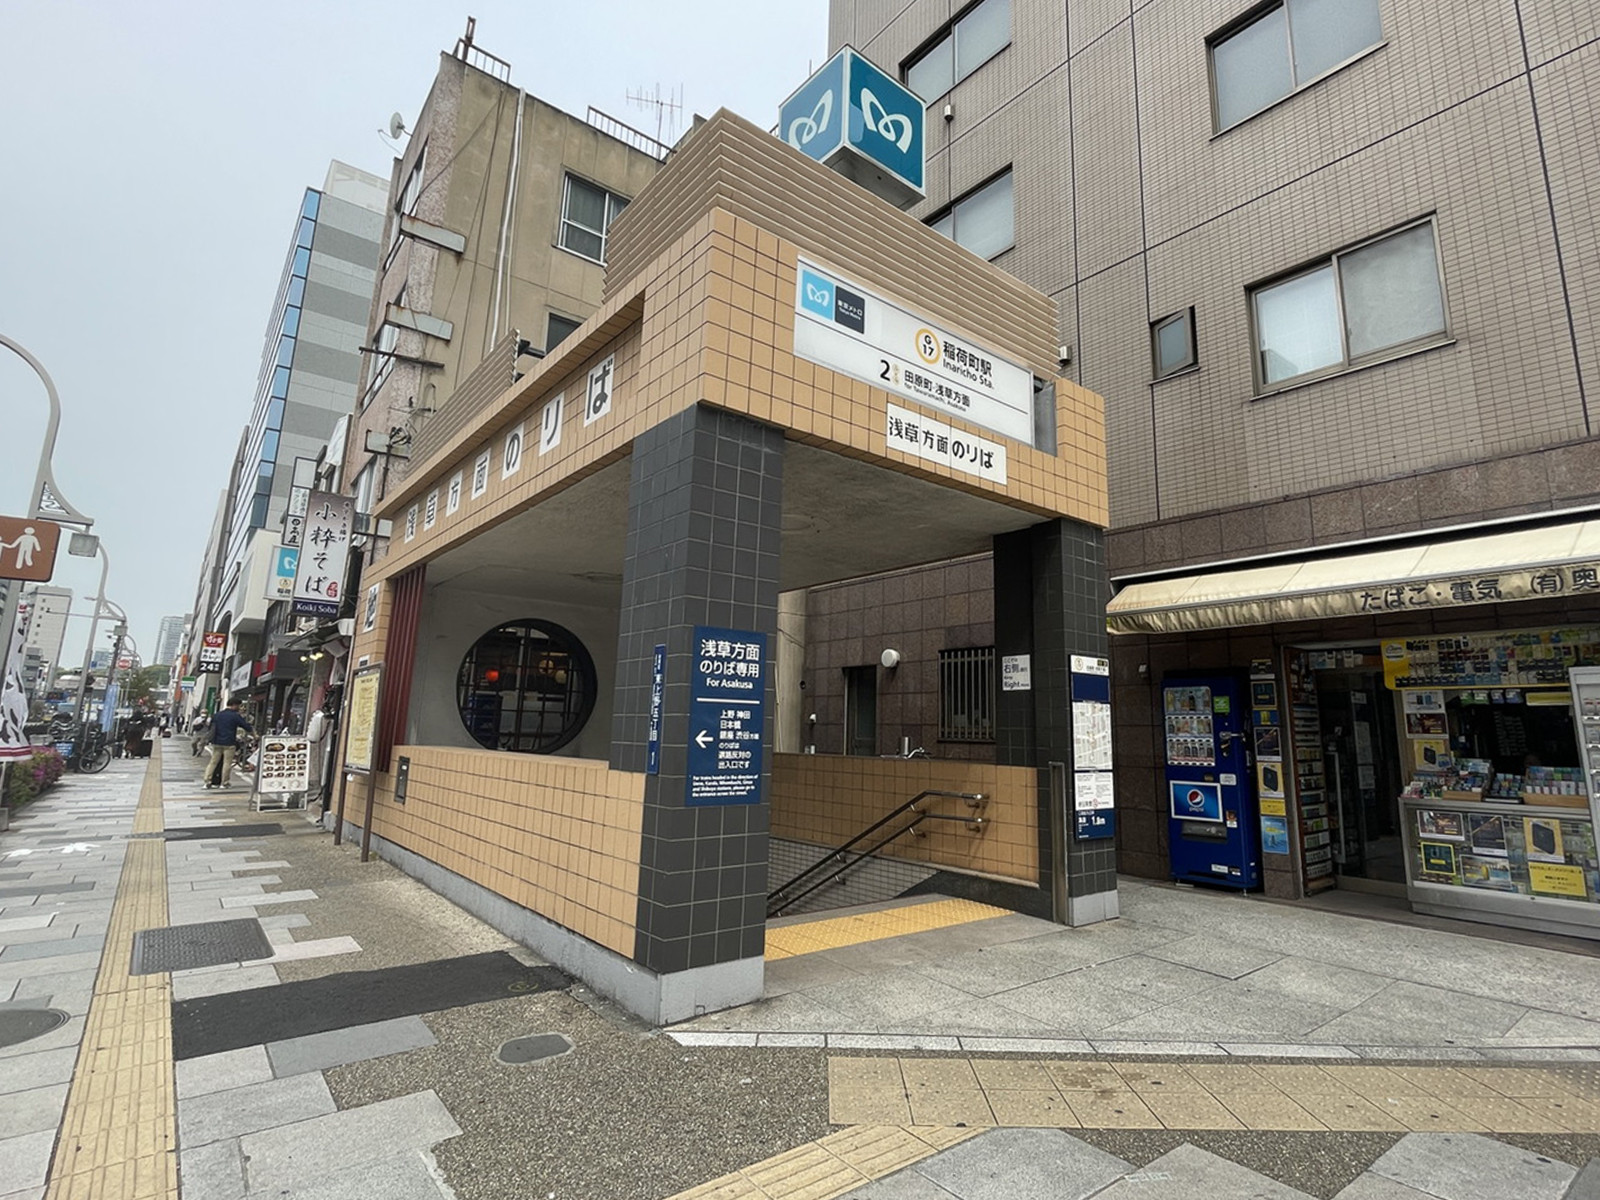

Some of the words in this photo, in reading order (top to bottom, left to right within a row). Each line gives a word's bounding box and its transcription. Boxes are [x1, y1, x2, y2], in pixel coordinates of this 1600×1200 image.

[924, 334, 932, 345] G
[923, 344, 934, 356] 17
[943, 340, 992, 378] 稲荷町駅
[880, 359, 891, 381] 2
[943, 358, 978, 381] Inaricho
[979, 374, 995, 389] Sta.
[889, 416, 994, 470] 浅草方面のりば
[305, 503, 337, 594] 小粋そば
[296, 603, 317, 612] Koiki
[318, 604, 337, 613] Soba
[701, 639, 760, 661] 浅草方面
[700, 660, 760, 678] のりば専用
[706, 677, 720, 688] For
[721, 678, 753, 689] Asakusa
[720, 709, 735, 719] 上野
[720, 720, 741, 729] 日本橋
